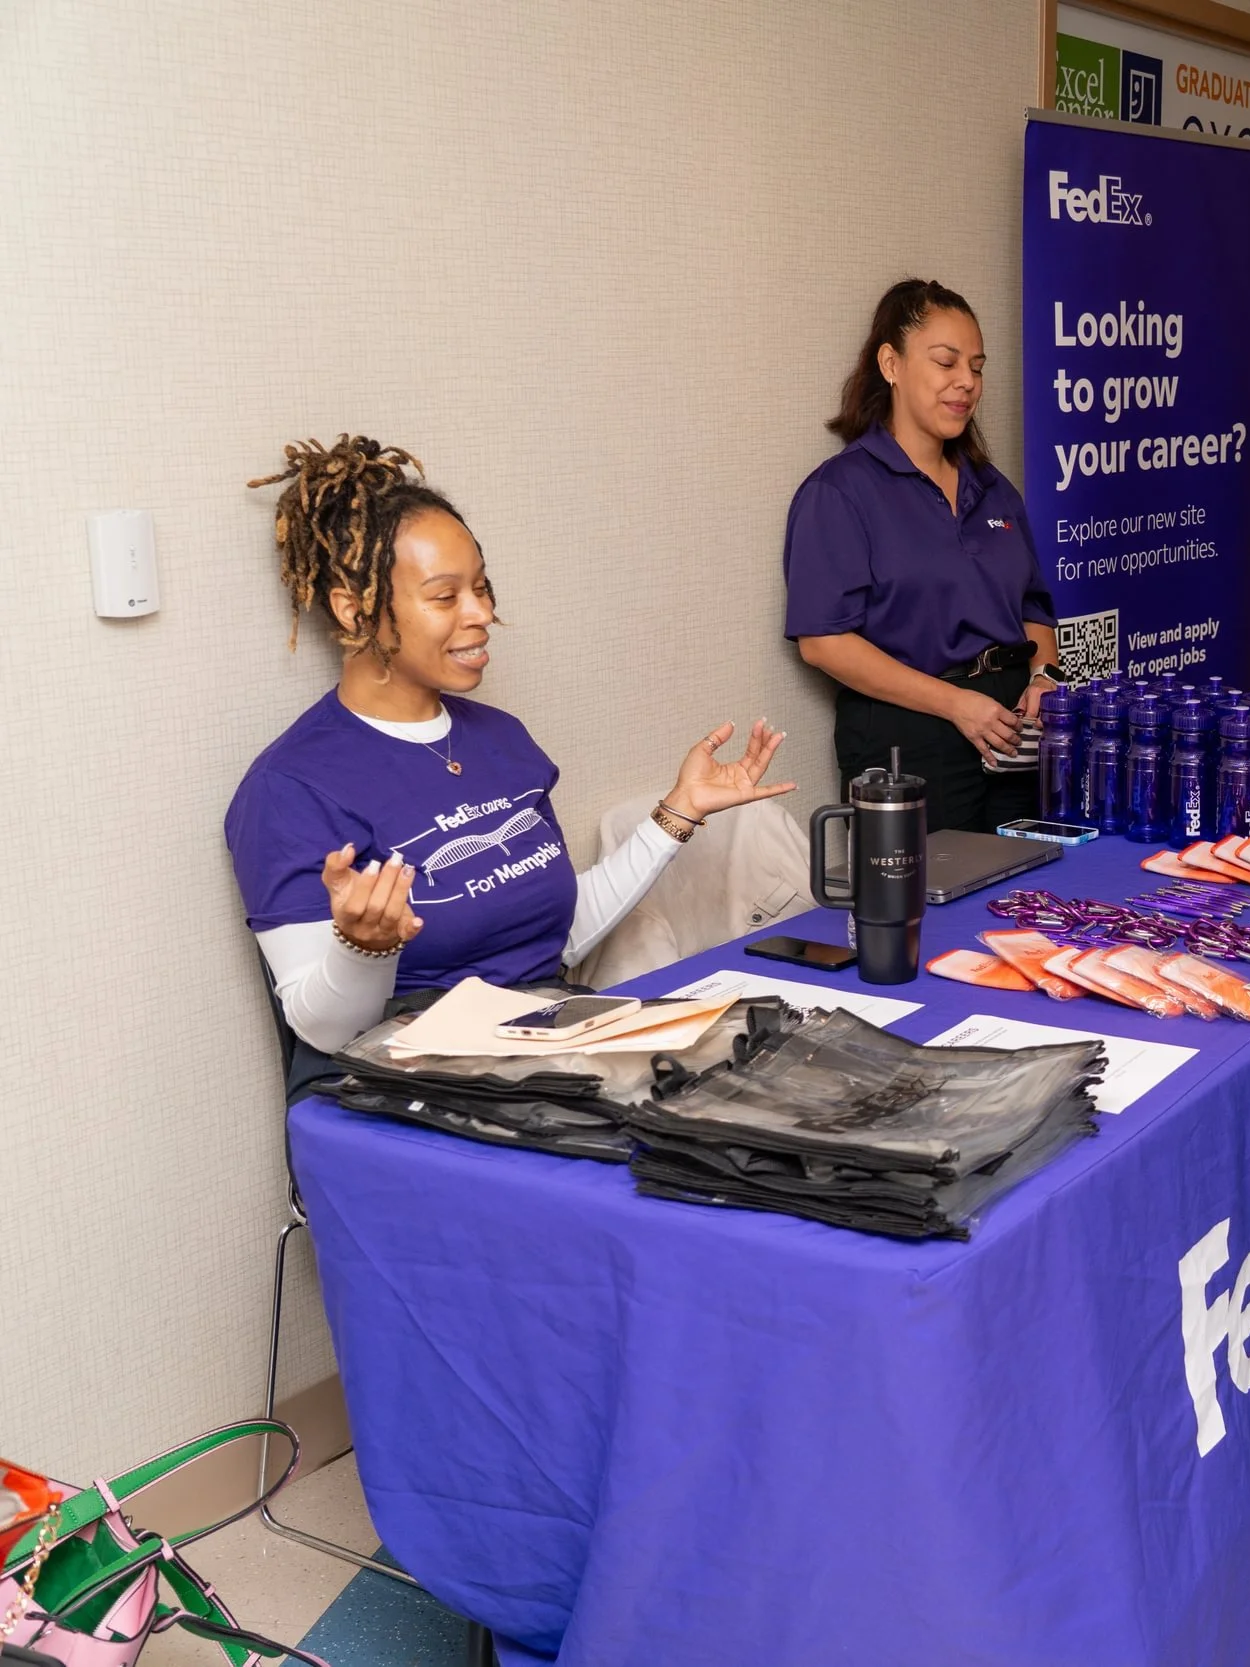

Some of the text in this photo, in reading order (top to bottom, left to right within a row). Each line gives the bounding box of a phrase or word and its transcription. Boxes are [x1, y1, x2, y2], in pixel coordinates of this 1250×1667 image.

[1056, 50, 1105, 106] xcel
[1053, 300, 1184, 359] Looking
[1053, 368, 1179, 424] to grow
[1054, 422, 1247, 491] your career?
[1057, 504, 1206, 547] Explore our new site
[1056, 538, 1219, 582] for new opportunities.
[1127, 617, 1220, 652] View and apply
[1127, 646, 1206, 679] for open jobs
[434, 797, 513, 832] FedEx cares
[464, 842, 562, 898] For Memphis
[870, 853, 923, 866] WESTERLY
